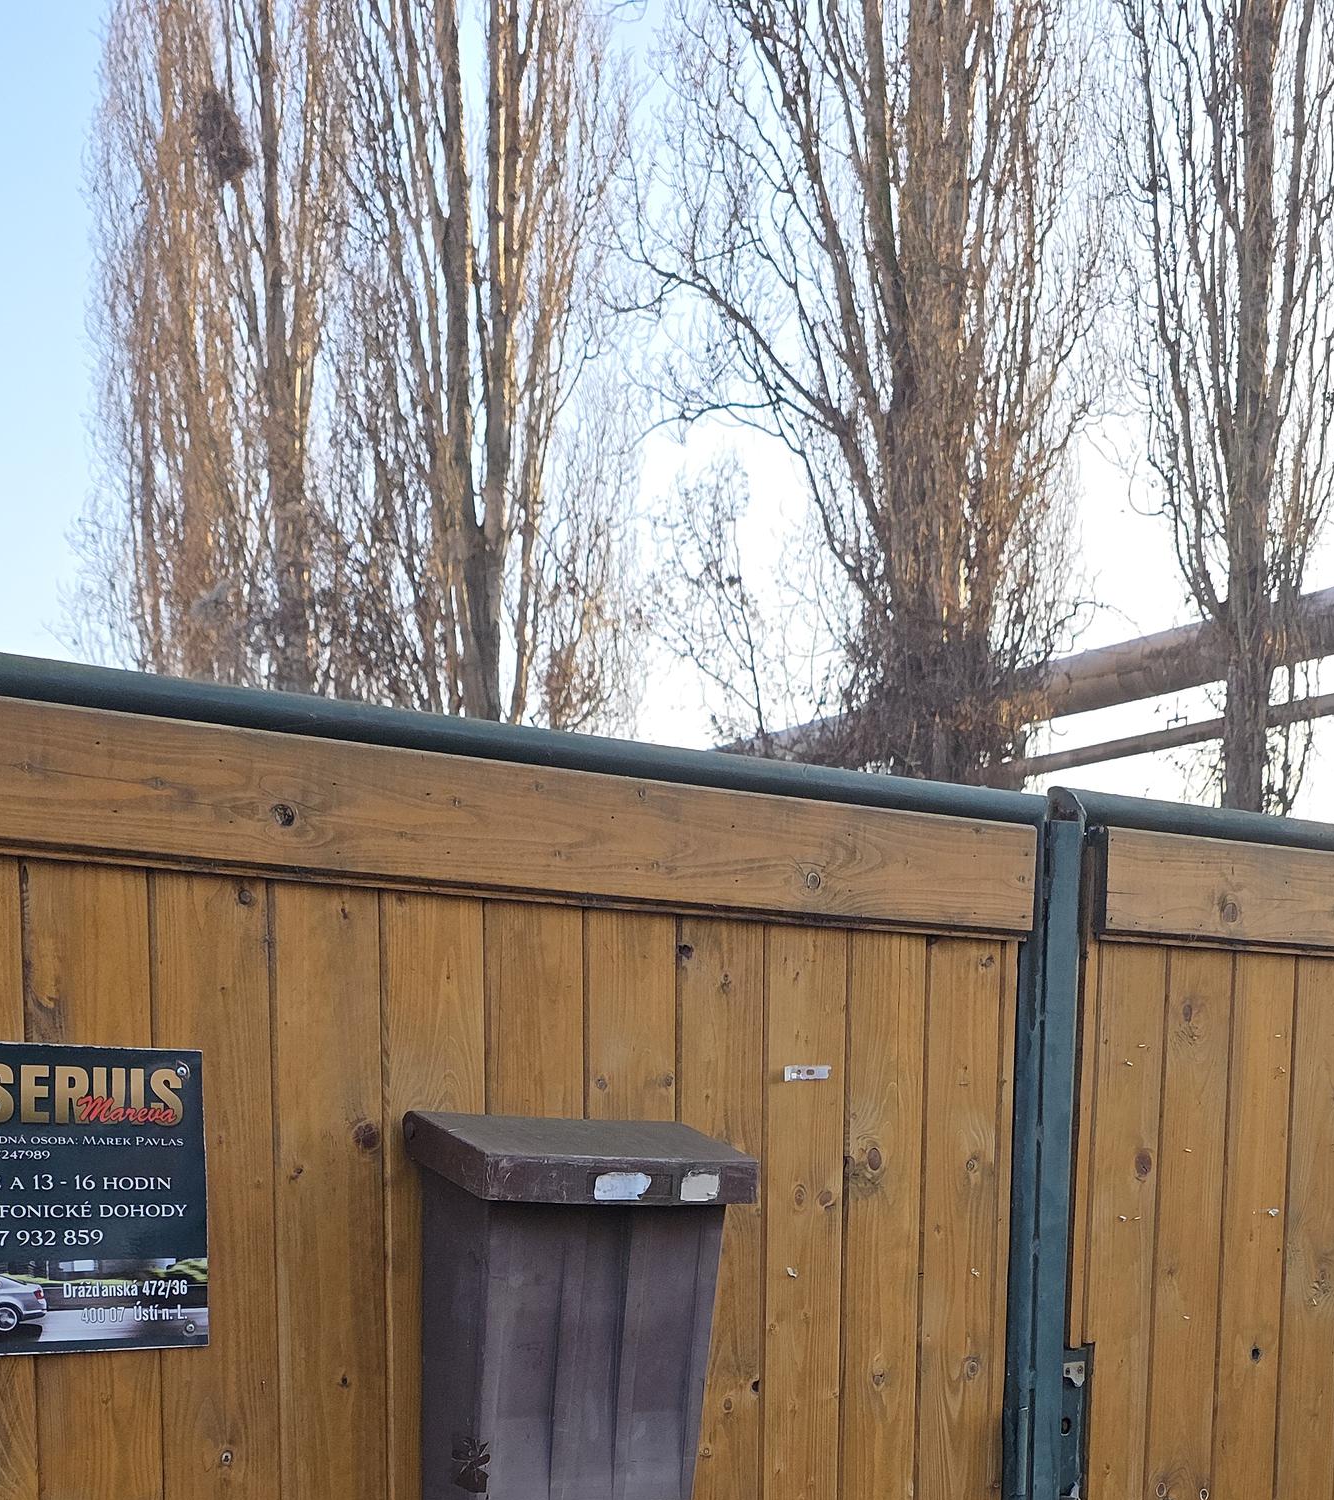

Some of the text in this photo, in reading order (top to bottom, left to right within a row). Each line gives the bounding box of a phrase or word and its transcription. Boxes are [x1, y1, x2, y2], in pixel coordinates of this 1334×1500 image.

[77, 1095, 177, 1124] Mareva
[30, 1136, 79, 1146] OSOBA:
[82, 1135, 132, 1146] MAREK
[136, 1136, 184, 1147] PAVLAS
[9, 1176, 25, 1190] A
[33, 1174, 54, 1190] 13
[74, 1174, 96, 1190] 16
[103, 1176, 172, 1190] HODIN
[99, 1204, 188, 1218] DOHODY
[16, 1229, 56, 1246] 932
[63, 1229, 104, 1246] 859
[62, 1279, 188, 1299] Drážďanská 472/36
[81, 1301, 188, 1323] 400 07 Ústí n. L.
